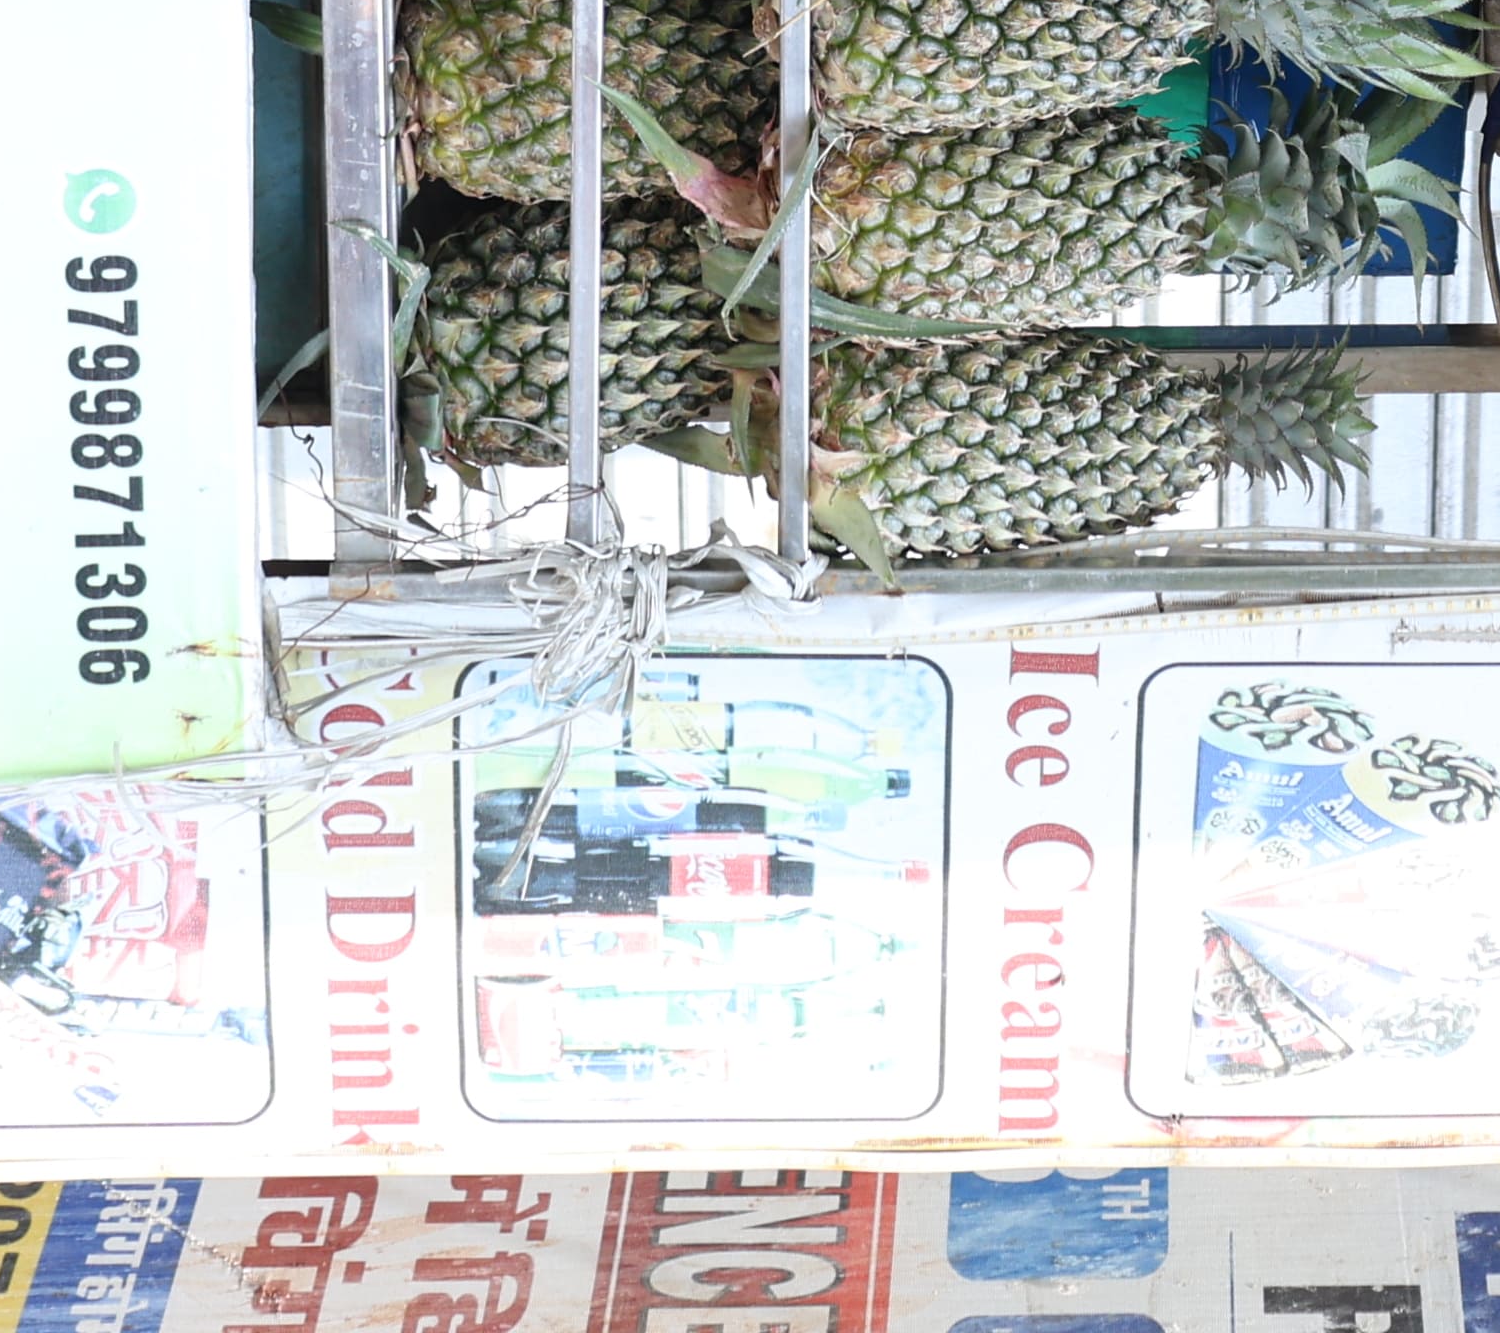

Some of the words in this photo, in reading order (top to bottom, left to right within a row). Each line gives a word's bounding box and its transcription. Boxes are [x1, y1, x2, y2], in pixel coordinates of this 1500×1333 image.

[64, 255, 151, 686] 9799871306
[1006, 642, 1100, 789] Ice
[997, 823, 1096, 1134] Cream
